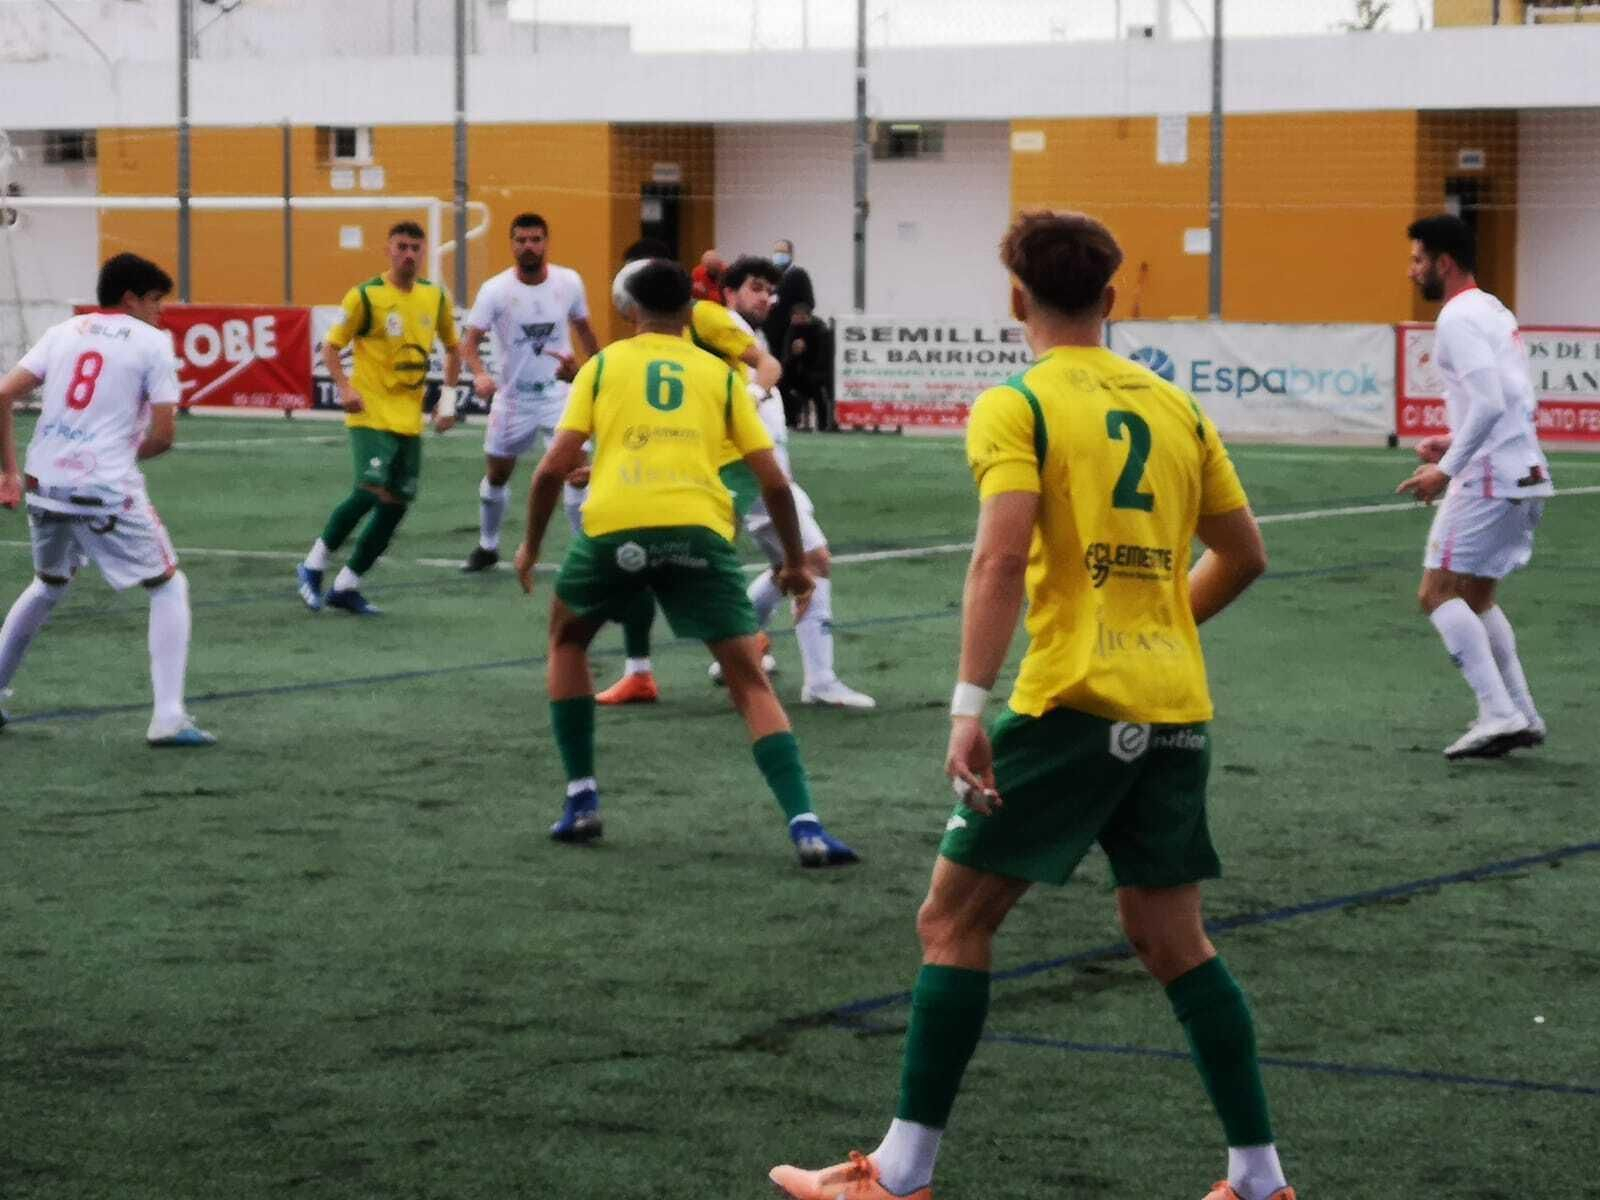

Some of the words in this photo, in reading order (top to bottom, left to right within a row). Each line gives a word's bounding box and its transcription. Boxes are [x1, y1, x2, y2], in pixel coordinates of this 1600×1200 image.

[177, 315, 277, 368] OBE
[844, 351, 877, 363] EL
[1557, 342, 1581, 358] DE
[66, 351, 104, 411] 8
[646, 360, 684, 412] 6
[1191, 360, 1379, 399] Espabrok
[1106, 410, 1155, 512] 2
